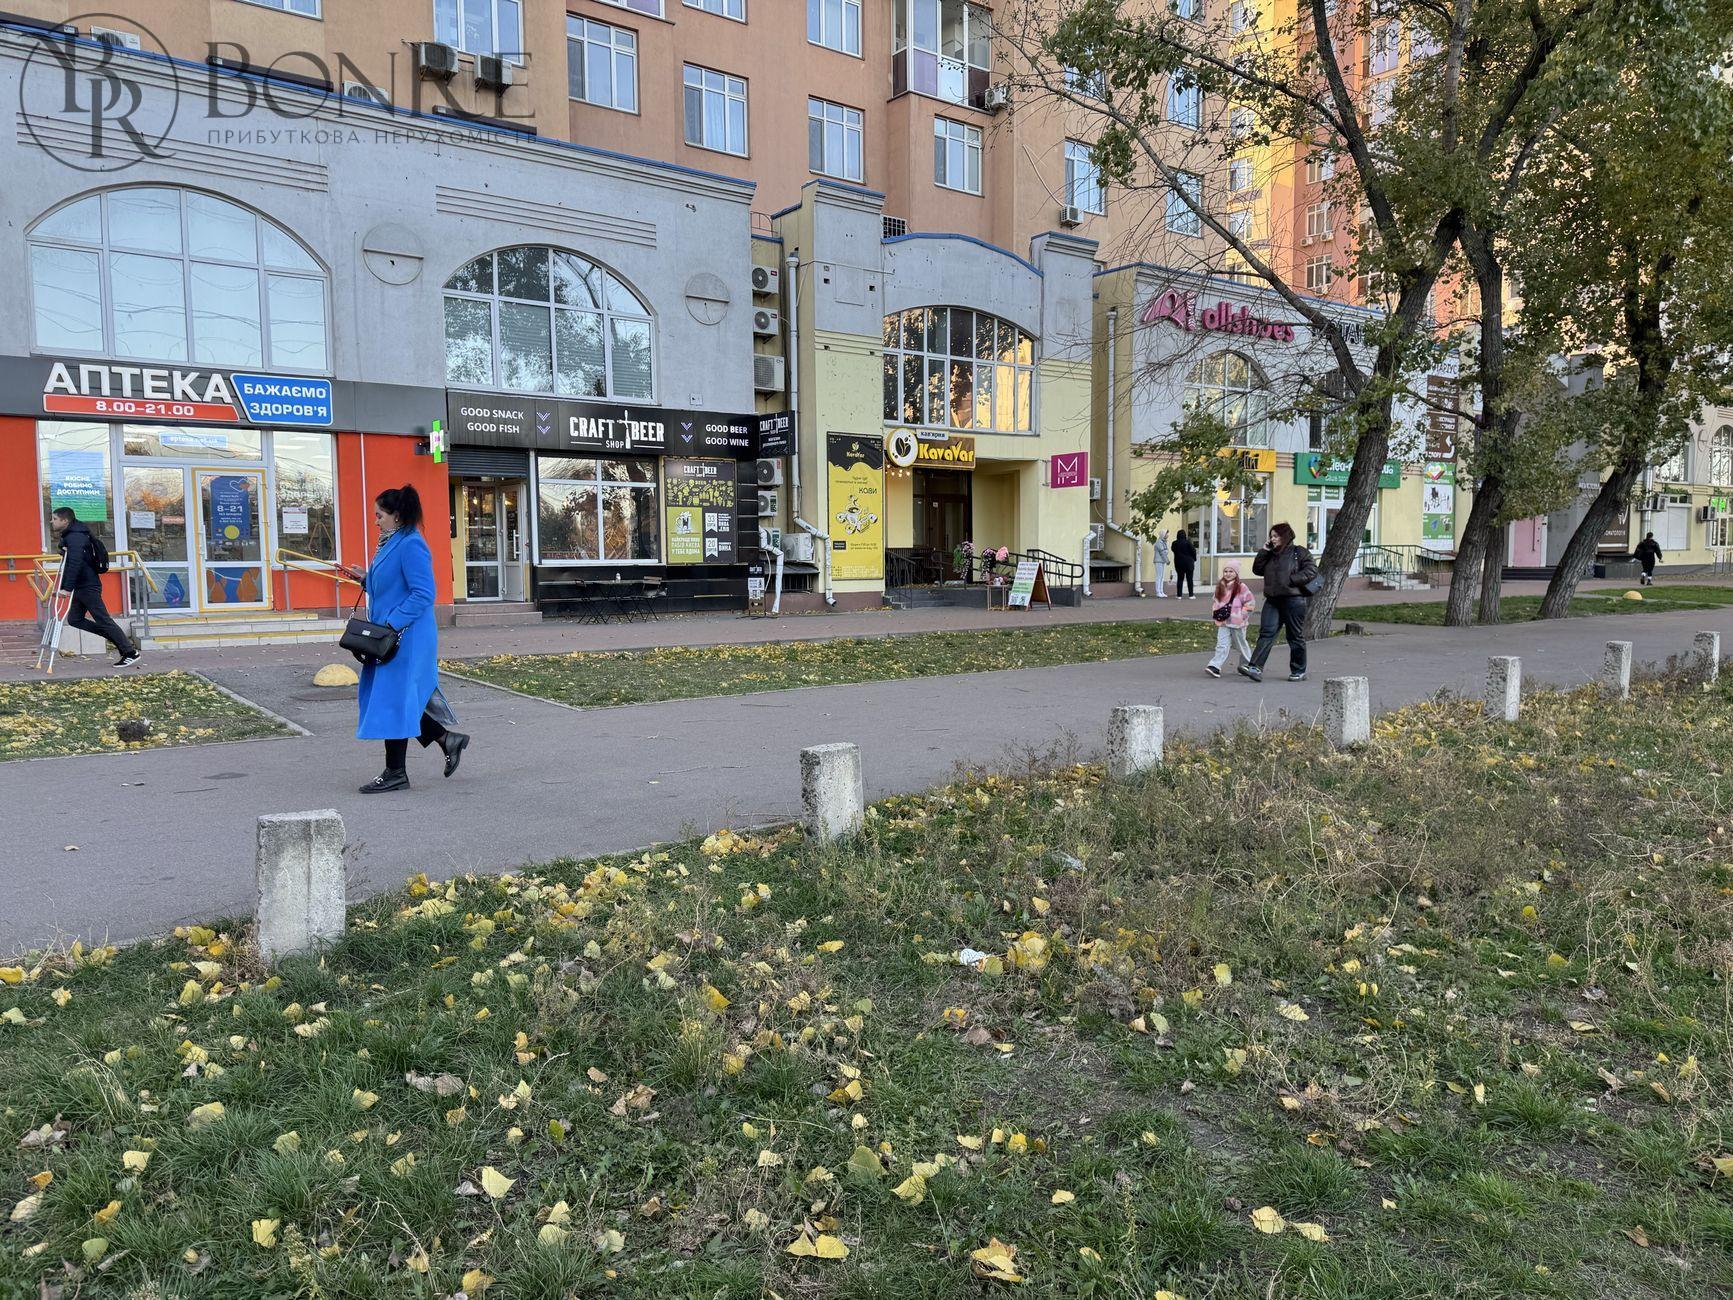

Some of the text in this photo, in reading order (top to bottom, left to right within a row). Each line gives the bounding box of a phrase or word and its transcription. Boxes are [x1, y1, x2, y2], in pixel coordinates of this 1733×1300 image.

[43, 362, 233, 403] АПТЕКА
[243, 383, 327, 399] БАЖАЄМО
[249, 402, 327, 417] ЗДОРОВ'Я
[460, 407, 525, 420] GOOD SNACK
[467, 422, 520, 434] GOOD FISH
[569, 416, 665, 442] CRAFT BEER
[705, 424, 748, 434] GOOD BEER
[760, 416, 789, 431] CRAFT BEER
[605, 440, 625, 449] SHOP
[705, 437, 749, 447] GOOD WINE
[918, 441, 974, 462] KavaVar
[683, 465, 717, 474] CRAFT BEER
[708, 514, 716, 522] 33
[708, 539, 716, 547] 20
